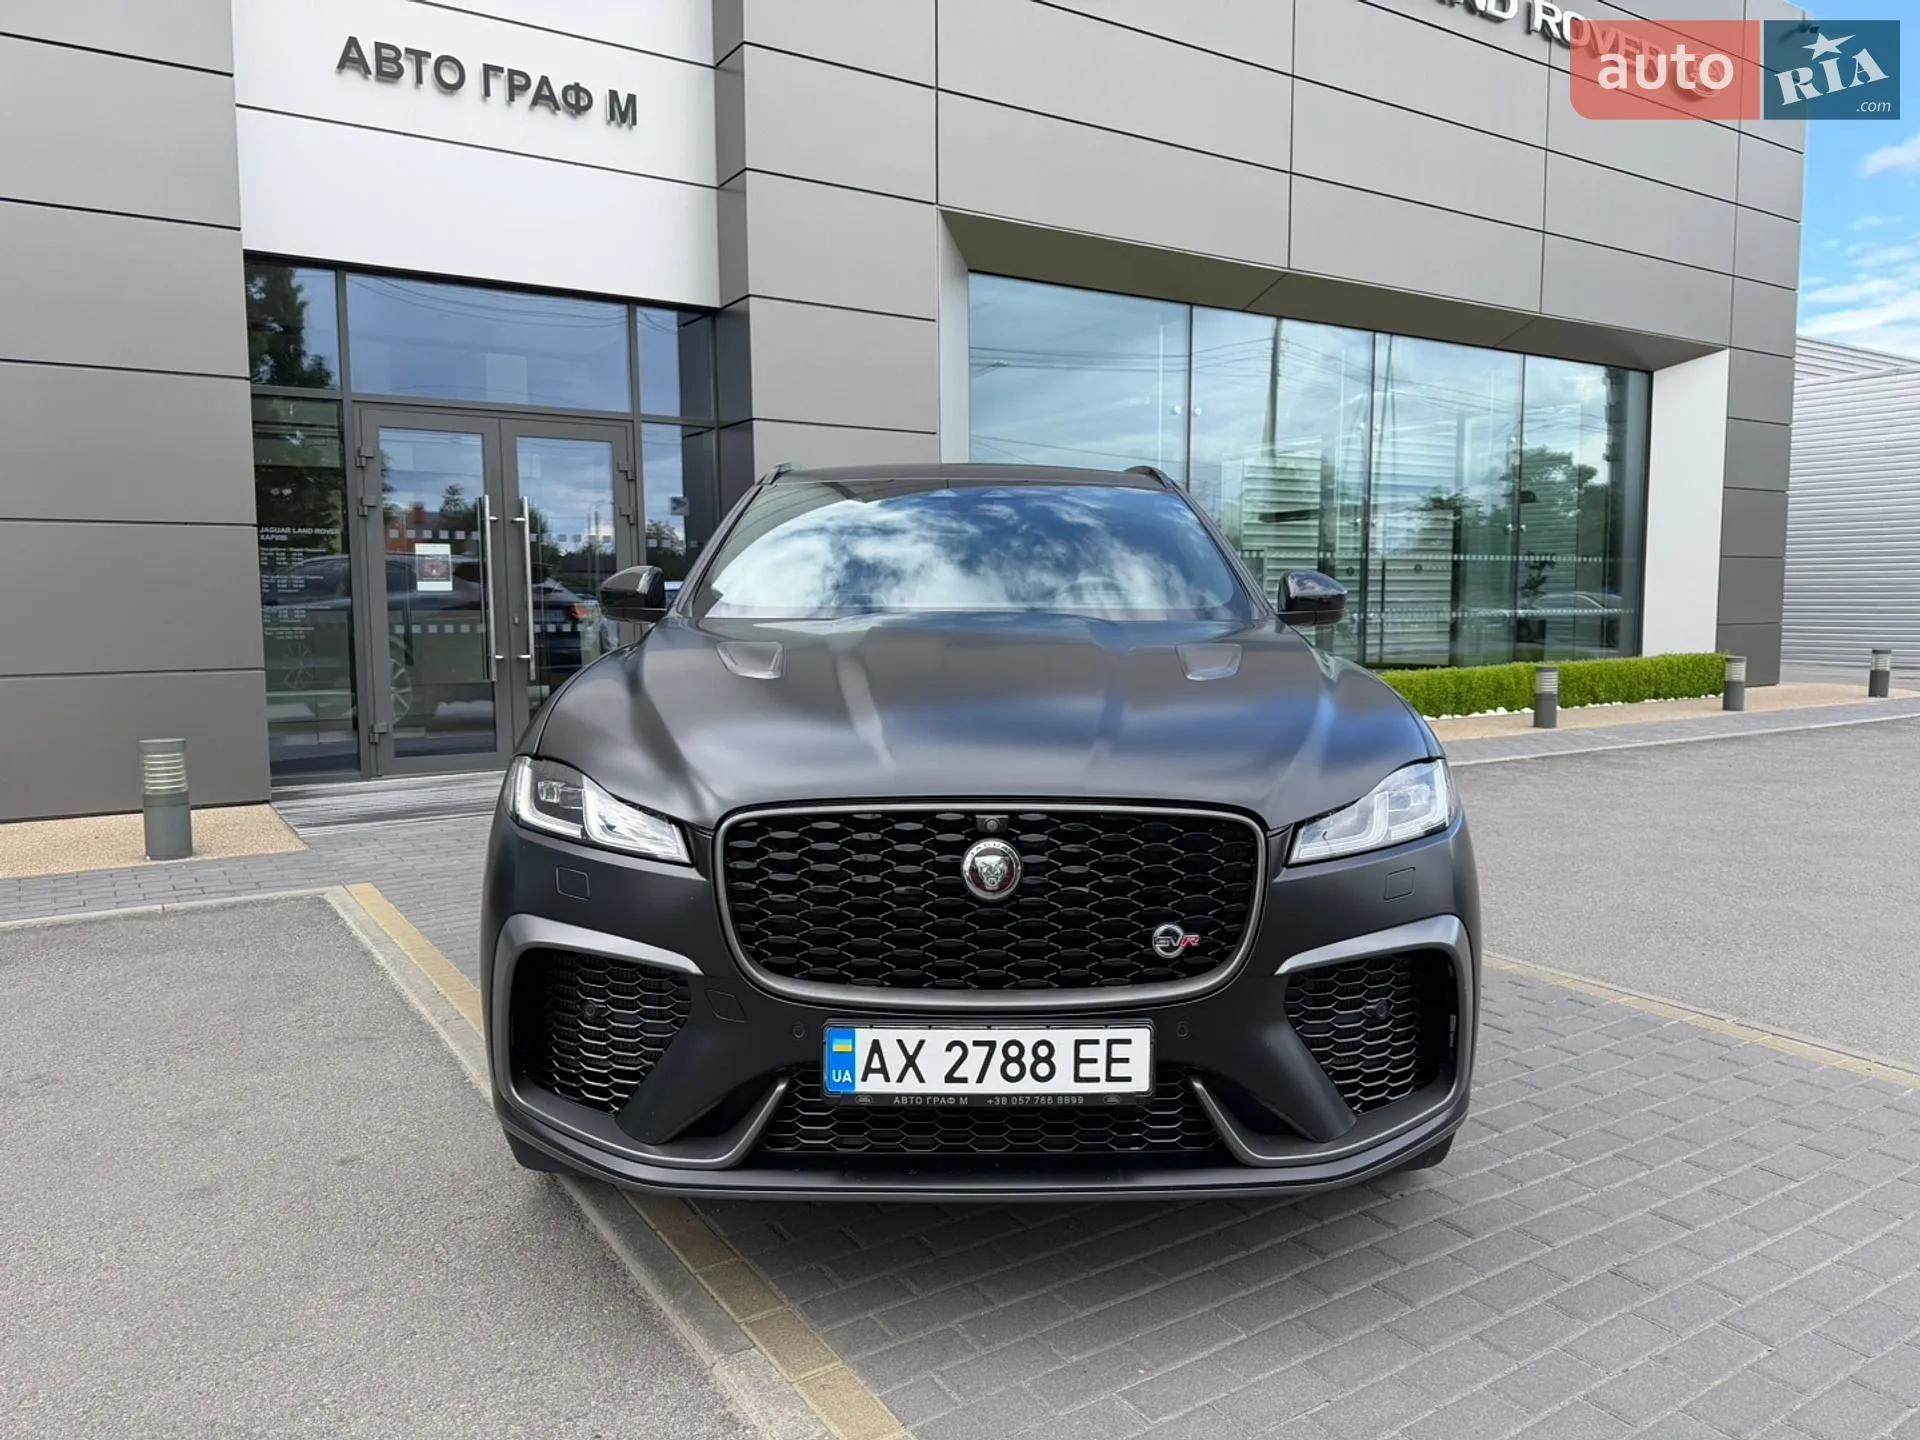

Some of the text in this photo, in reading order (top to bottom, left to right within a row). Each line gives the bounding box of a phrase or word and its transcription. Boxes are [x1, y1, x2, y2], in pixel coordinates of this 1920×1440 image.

[336, 35, 637, 127] АВТО ГРАФ М
[861, 1038, 1133, 1084] AX 2788 EE
[832, 1070, 852, 1083] UA
[893, 1096, 969, 1105] АВТО ГРАФ М
